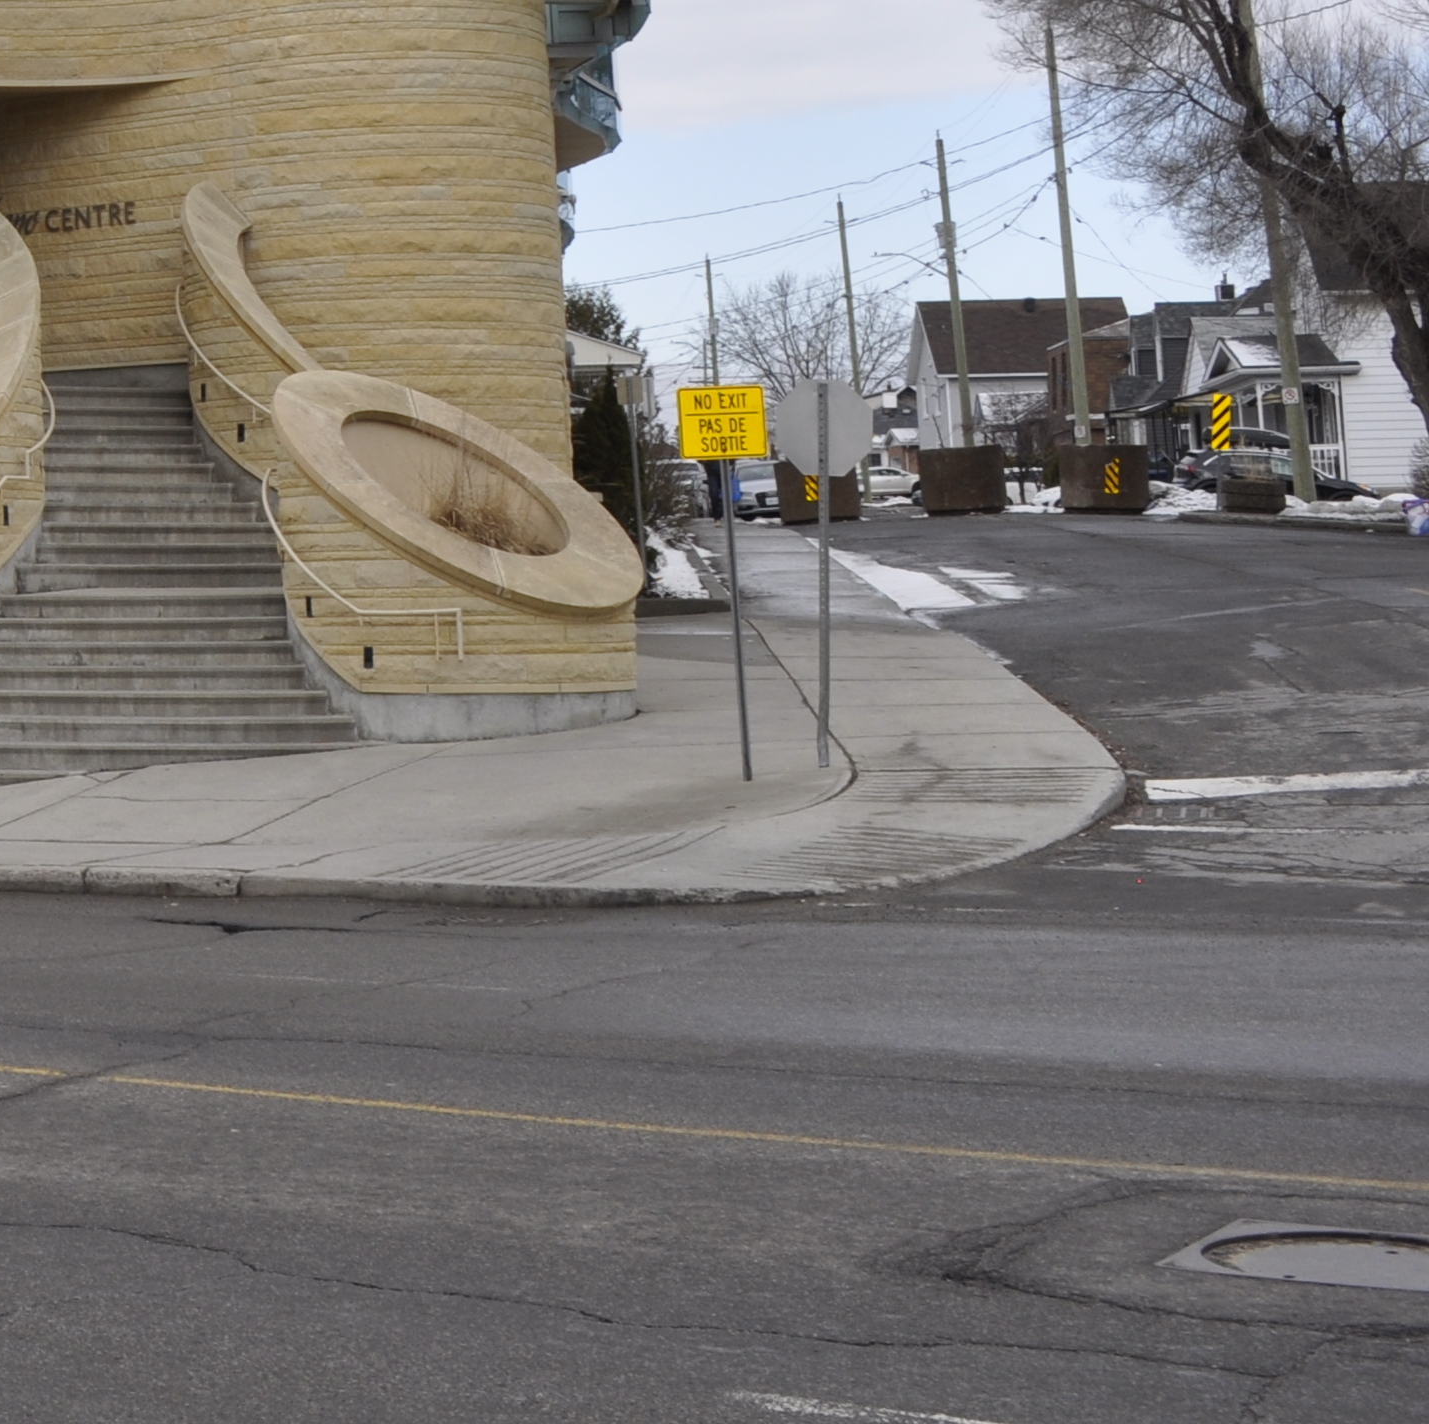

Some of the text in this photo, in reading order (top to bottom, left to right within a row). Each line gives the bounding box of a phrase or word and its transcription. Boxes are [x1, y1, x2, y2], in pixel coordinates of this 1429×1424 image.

[45, 201, 136, 232] CENTRE
[694, 392, 747, 410] NO EXIT
[699, 417, 747, 434] PAS DE
[701, 436, 748, 453] SORTIE
